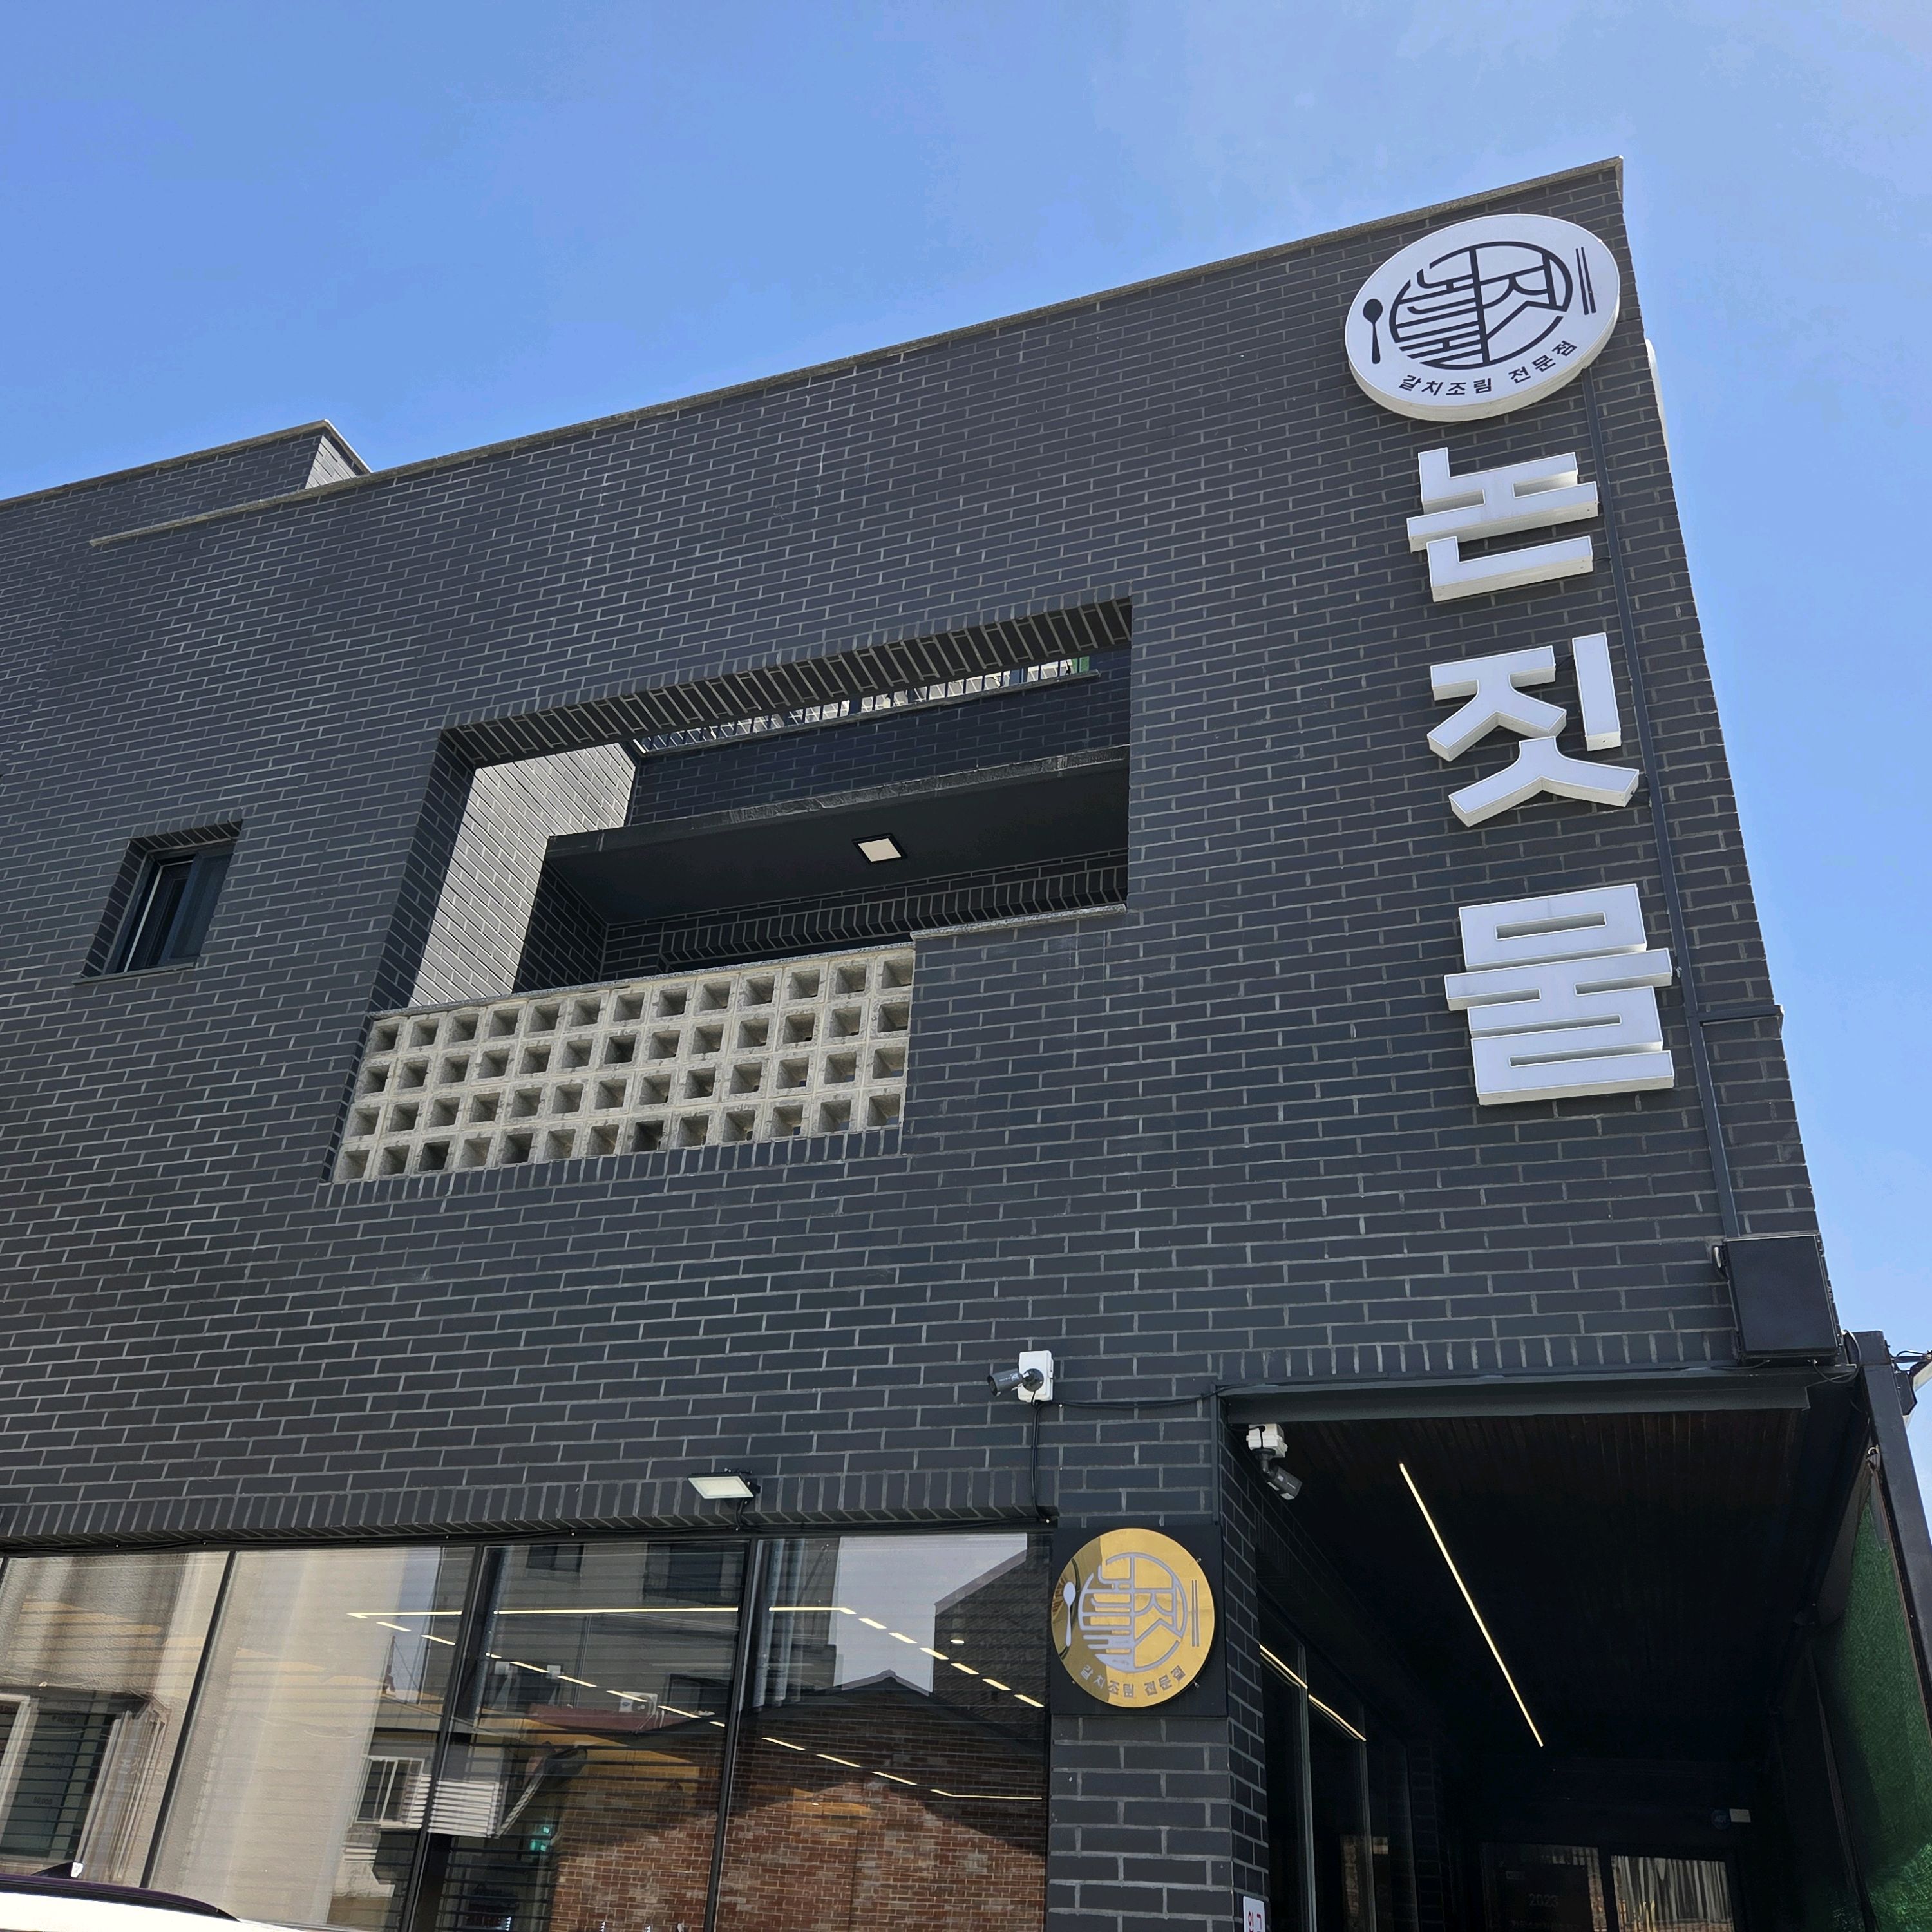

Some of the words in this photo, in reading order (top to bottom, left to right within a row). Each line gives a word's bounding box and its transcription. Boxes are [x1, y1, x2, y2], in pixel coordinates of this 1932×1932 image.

[1399, 375, 1492, 396] 갈치조림
[1508, 340, 1578, 384] 전문점
[1406, 447, 1675, 1106] 논짓물
[1080, 1664, 1134, 1698] 갈치조림
[1143, 1664, 1186, 1696] 전문점
